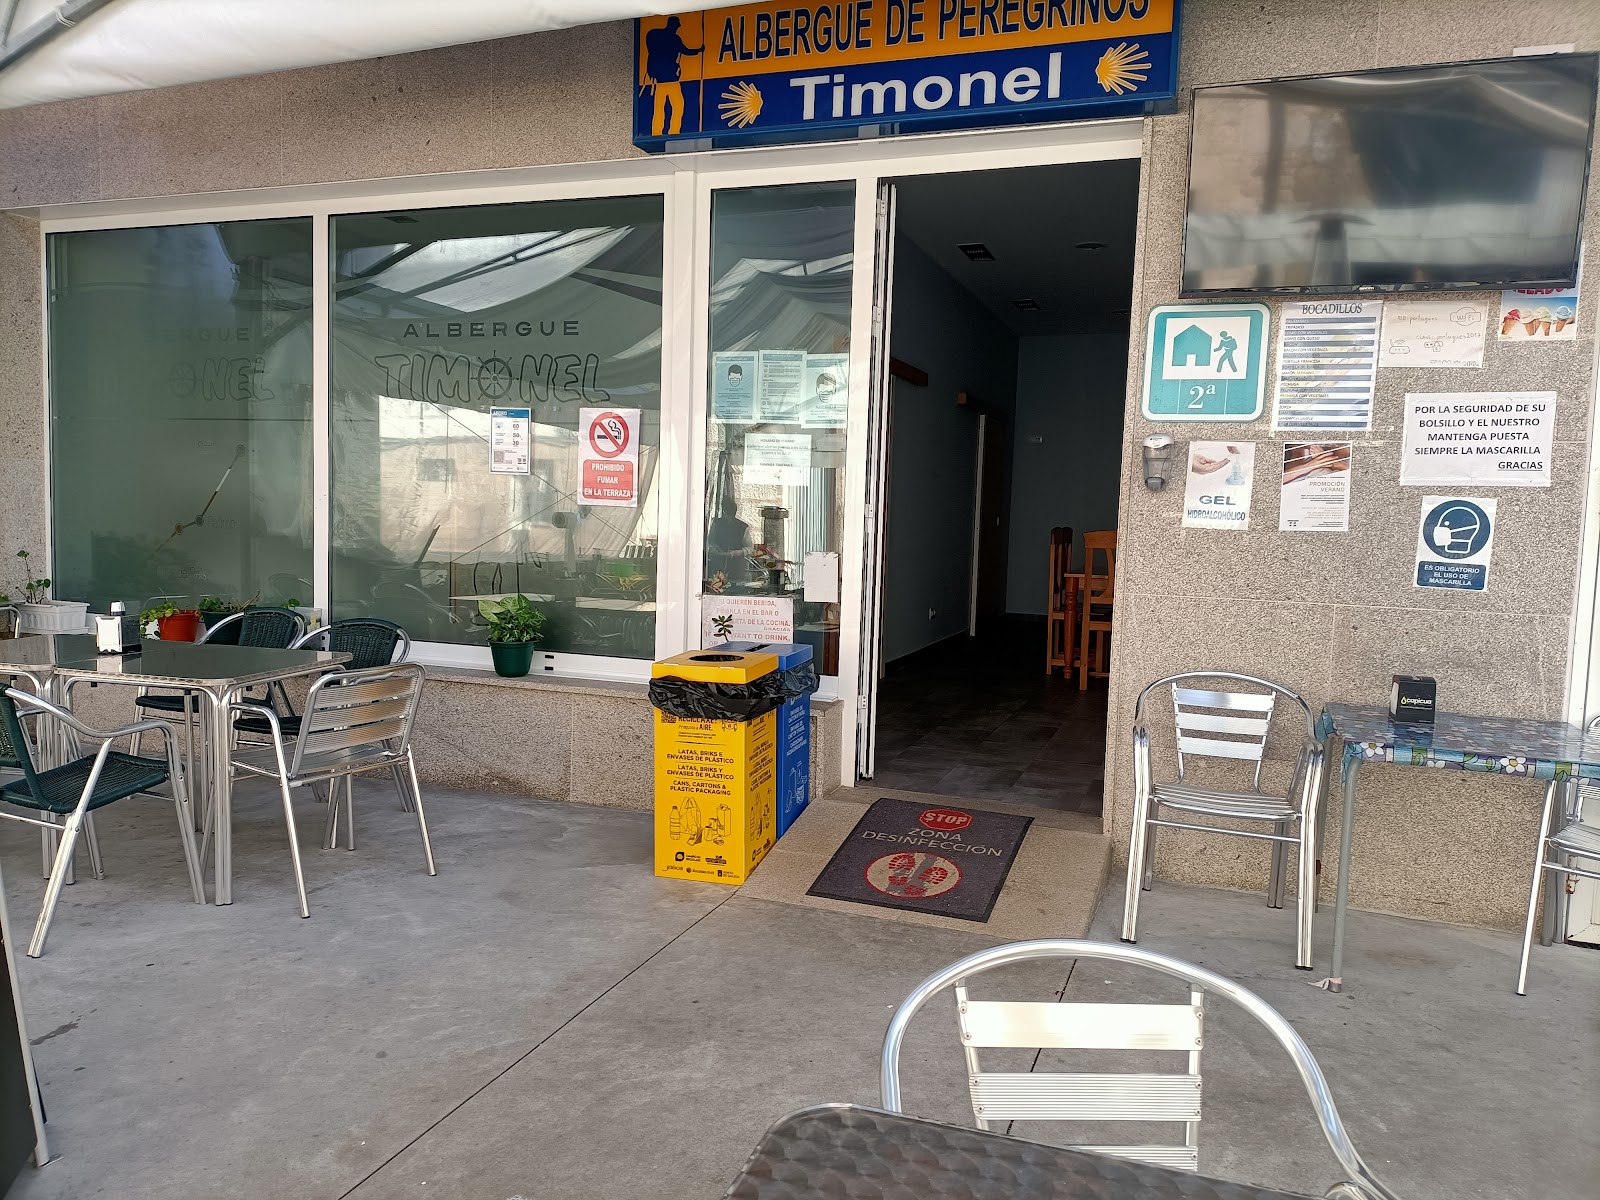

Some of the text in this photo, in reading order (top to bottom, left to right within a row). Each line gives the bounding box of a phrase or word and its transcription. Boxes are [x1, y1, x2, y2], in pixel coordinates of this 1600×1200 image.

[718, 0, 872, 63] ALBERGUE
[885, 0, 925, 46] DE
[789, 51, 1062, 121] Timonel
[1302, 303, 1363, 315] BOCADILLOS
[402, 320, 580, 339] ALBERGUE
[374, 352, 611, 404] TIMONEL
[1188, 384, 1216, 409] 2ª
[1415, 406, 1435, 414] POR
[1453, 405, 1512, 413] SEGURIDAD
[1516, 404, 1529, 412] DE
[1532, 404, 1546, 412] SU
[1420, 418, 1540, 428] BOLSILLO Y EL NUESTRO
[1428, 432, 1530, 441] MANTENGA PUESTA
[1415, 447, 1458, 455] SIEMPRE
[1476, 446, 1541, 455] MASCARILLA
[592, 463, 625, 471] PROHIBIDO
[1498, 462, 1543, 470] GRACIAS
[598, 476, 619, 484] FUMAR
[594, 488, 602, 496] LA
[604, 489, 631, 498] TERRAZA
[1199, 495, 1236, 505] GEL
[1188, 510, 1246, 521] HIDROALCOHÓLICO
[1434, 566, 1480, 574] OBLIGATORIO
[1429, 578, 1472, 586] MASCARILLA
[705, 756, 734, 764] PLÁSTICO
[705, 772, 734, 780] PLÁSTICO
[696, 787, 731, 795] PACKAGING
[924, 812, 967, 826] STOP
[907, 828, 962, 842] ZONA
[862, 830, 1003, 857] DESINFECCIÓN
